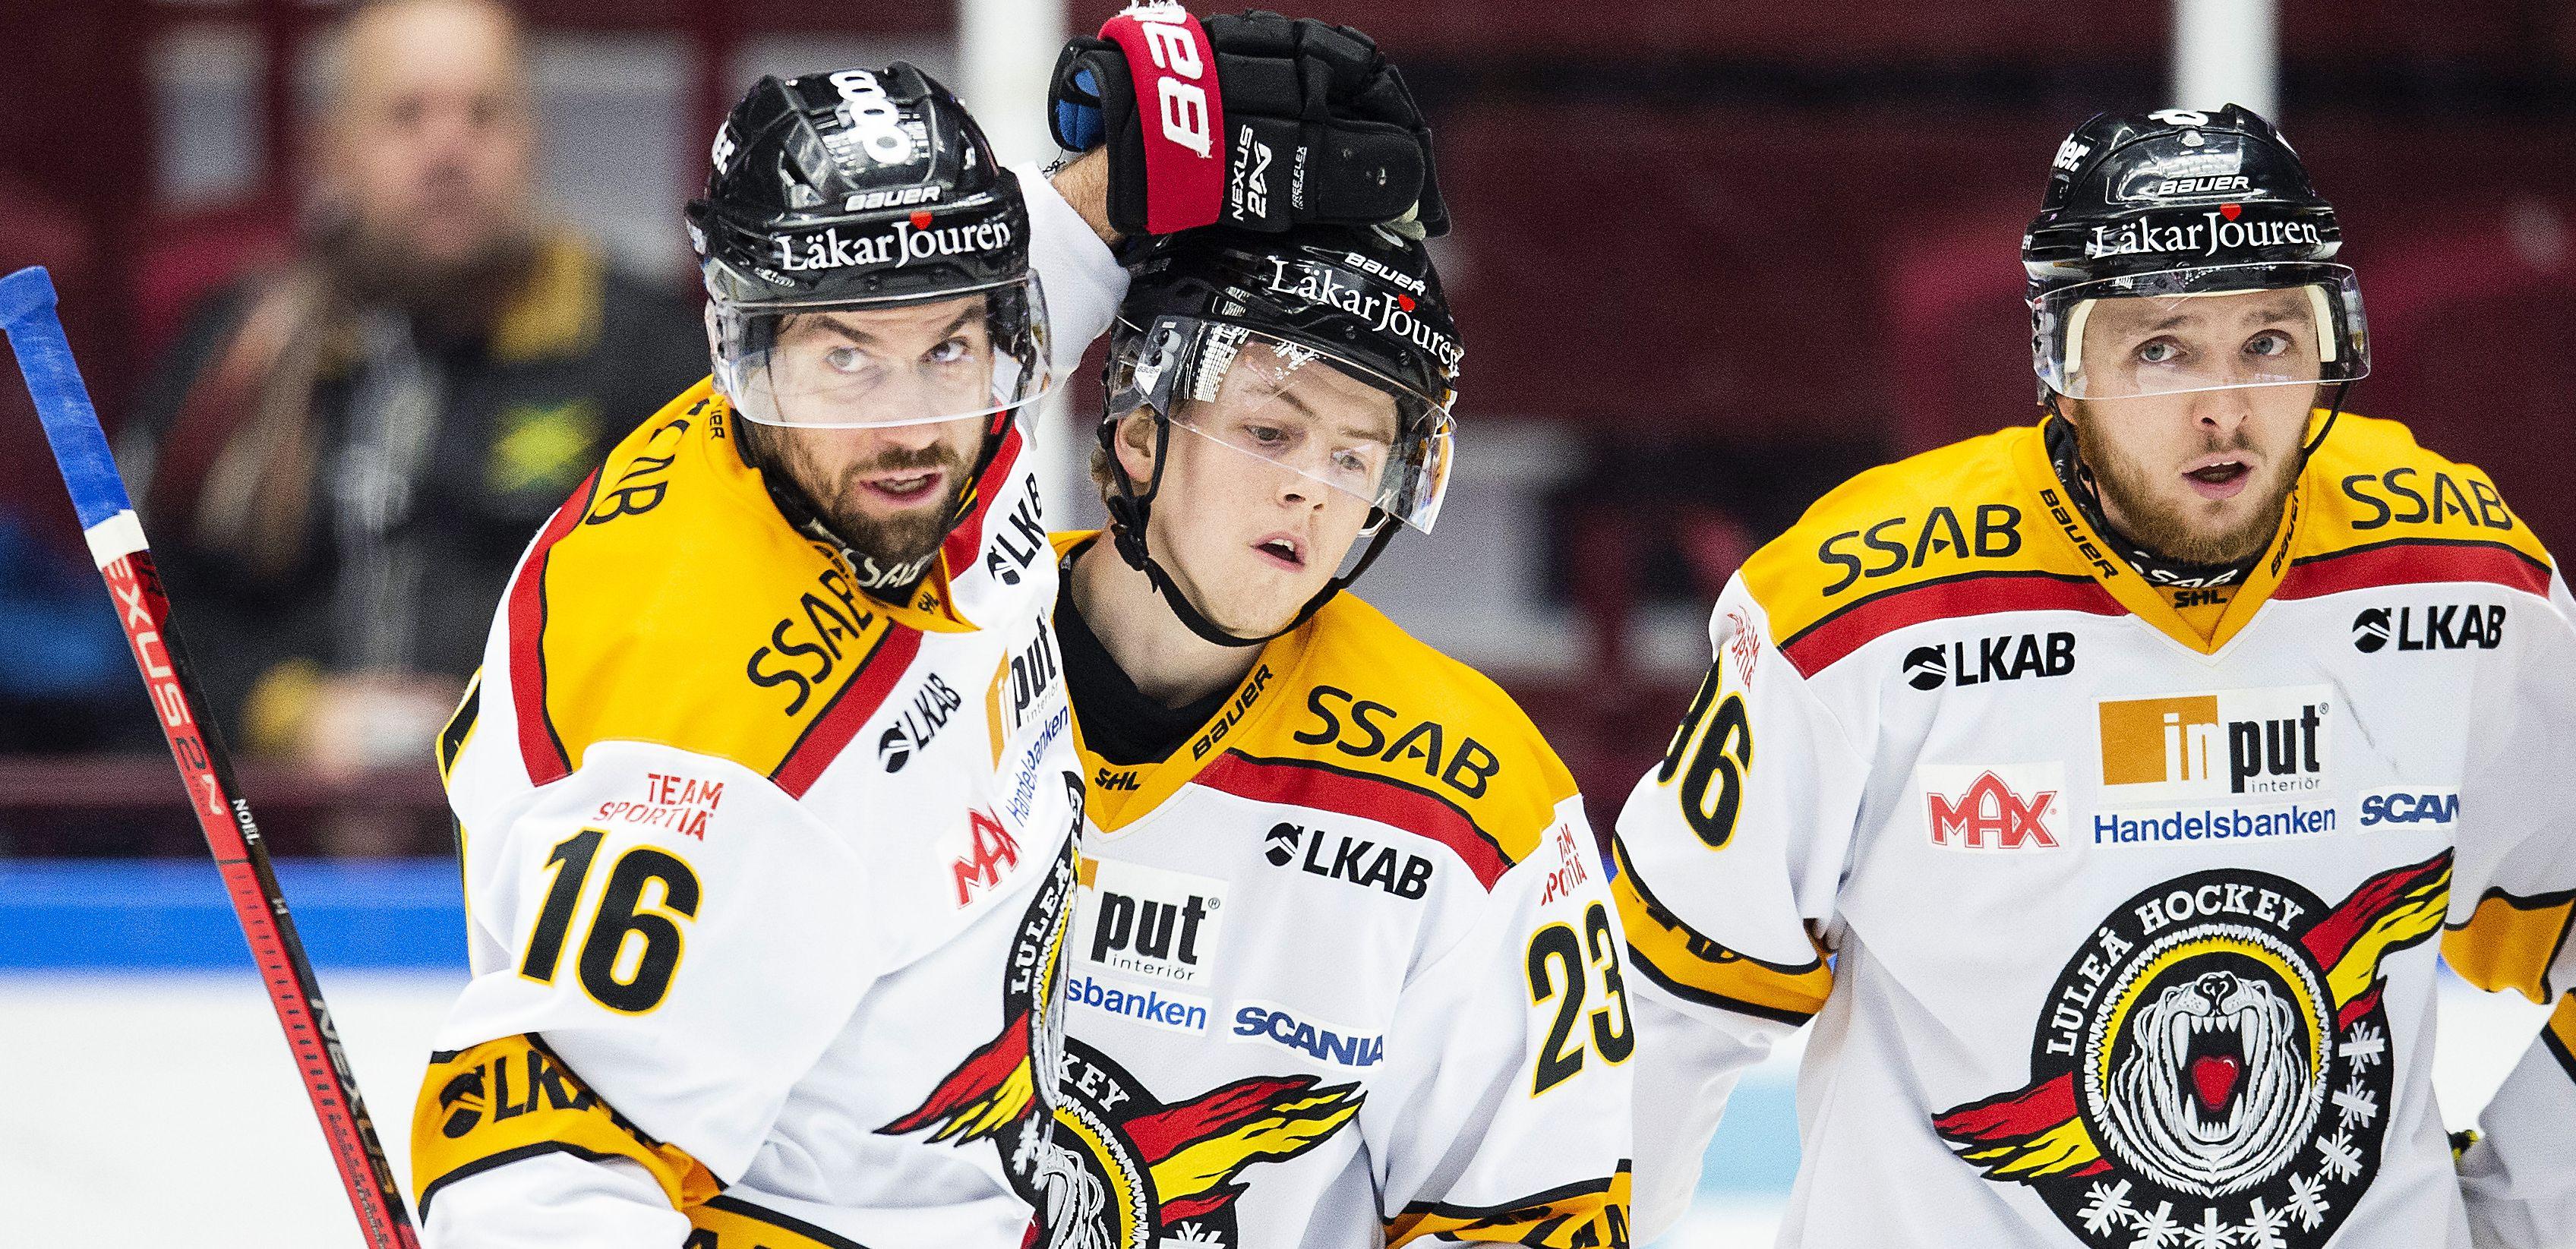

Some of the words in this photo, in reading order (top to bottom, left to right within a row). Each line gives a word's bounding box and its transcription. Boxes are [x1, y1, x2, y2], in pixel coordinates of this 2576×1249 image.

[1231, 124, 1254, 222] NEXUS
[1293, 145, 1307, 178] FLEX
[2158, 175, 2249, 197] BAUER
[844, 185, 942, 213] BAUER
[775, 221, 1012, 271] LäkarJouren
[2091, 212, 2322, 260] LäkarJouren
[1344, 253, 1426, 296] BAUER
[1267, 254, 1465, 379] LäkarJouren
[995, 472, 1046, 569] LKB
[2341, 467, 2514, 532] SSAB
[1817, 503, 2023, 598] SSAB
[2039, 488, 2119, 579] BAUER
[2174, 588, 2227, 608] SHL
[2398, 604, 2508, 651] LKAB
[107, 554, 191, 727] EXUS
[747, 569, 874, 718] SSAB
[1954, 630, 2076, 686] LKAB
[906, 672, 962, 752] LKAB
[1191, 664, 1273, 762] BAUER
[1293, 684, 1501, 800] SSAB
[648, 772, 724, 811] TEAM
[1005, 705, 1069, 828] Handelbanken
[1094, 768, 1140, 791] SHL
[2251, 777, 2321, 794] interiör
[592, 801, 704, 841] SPORTIA
[1924, 769, 2061, 850] MAX
[2094, 804, 2337, 844] Handelsbanken
[2360, 793, 2460, 826] SCAN
[1302, 830, 1433, 900] LKAB
[519, 828, 702, 1017] 16
[1090, 890, 1206, 964] put
[1113, 954, 1195, 982] interiör
[1524, 900, 1636, 1099] 23
[2046, 926, 2134, 1057] LULEÅ
[2135, 882, 2304, 937] HOCKEY
[1067, 977, 1207, 1030] sbanken
[494, 1049, 589, 1124] LK
[1059, 1050, 1131, 1112] KEY
